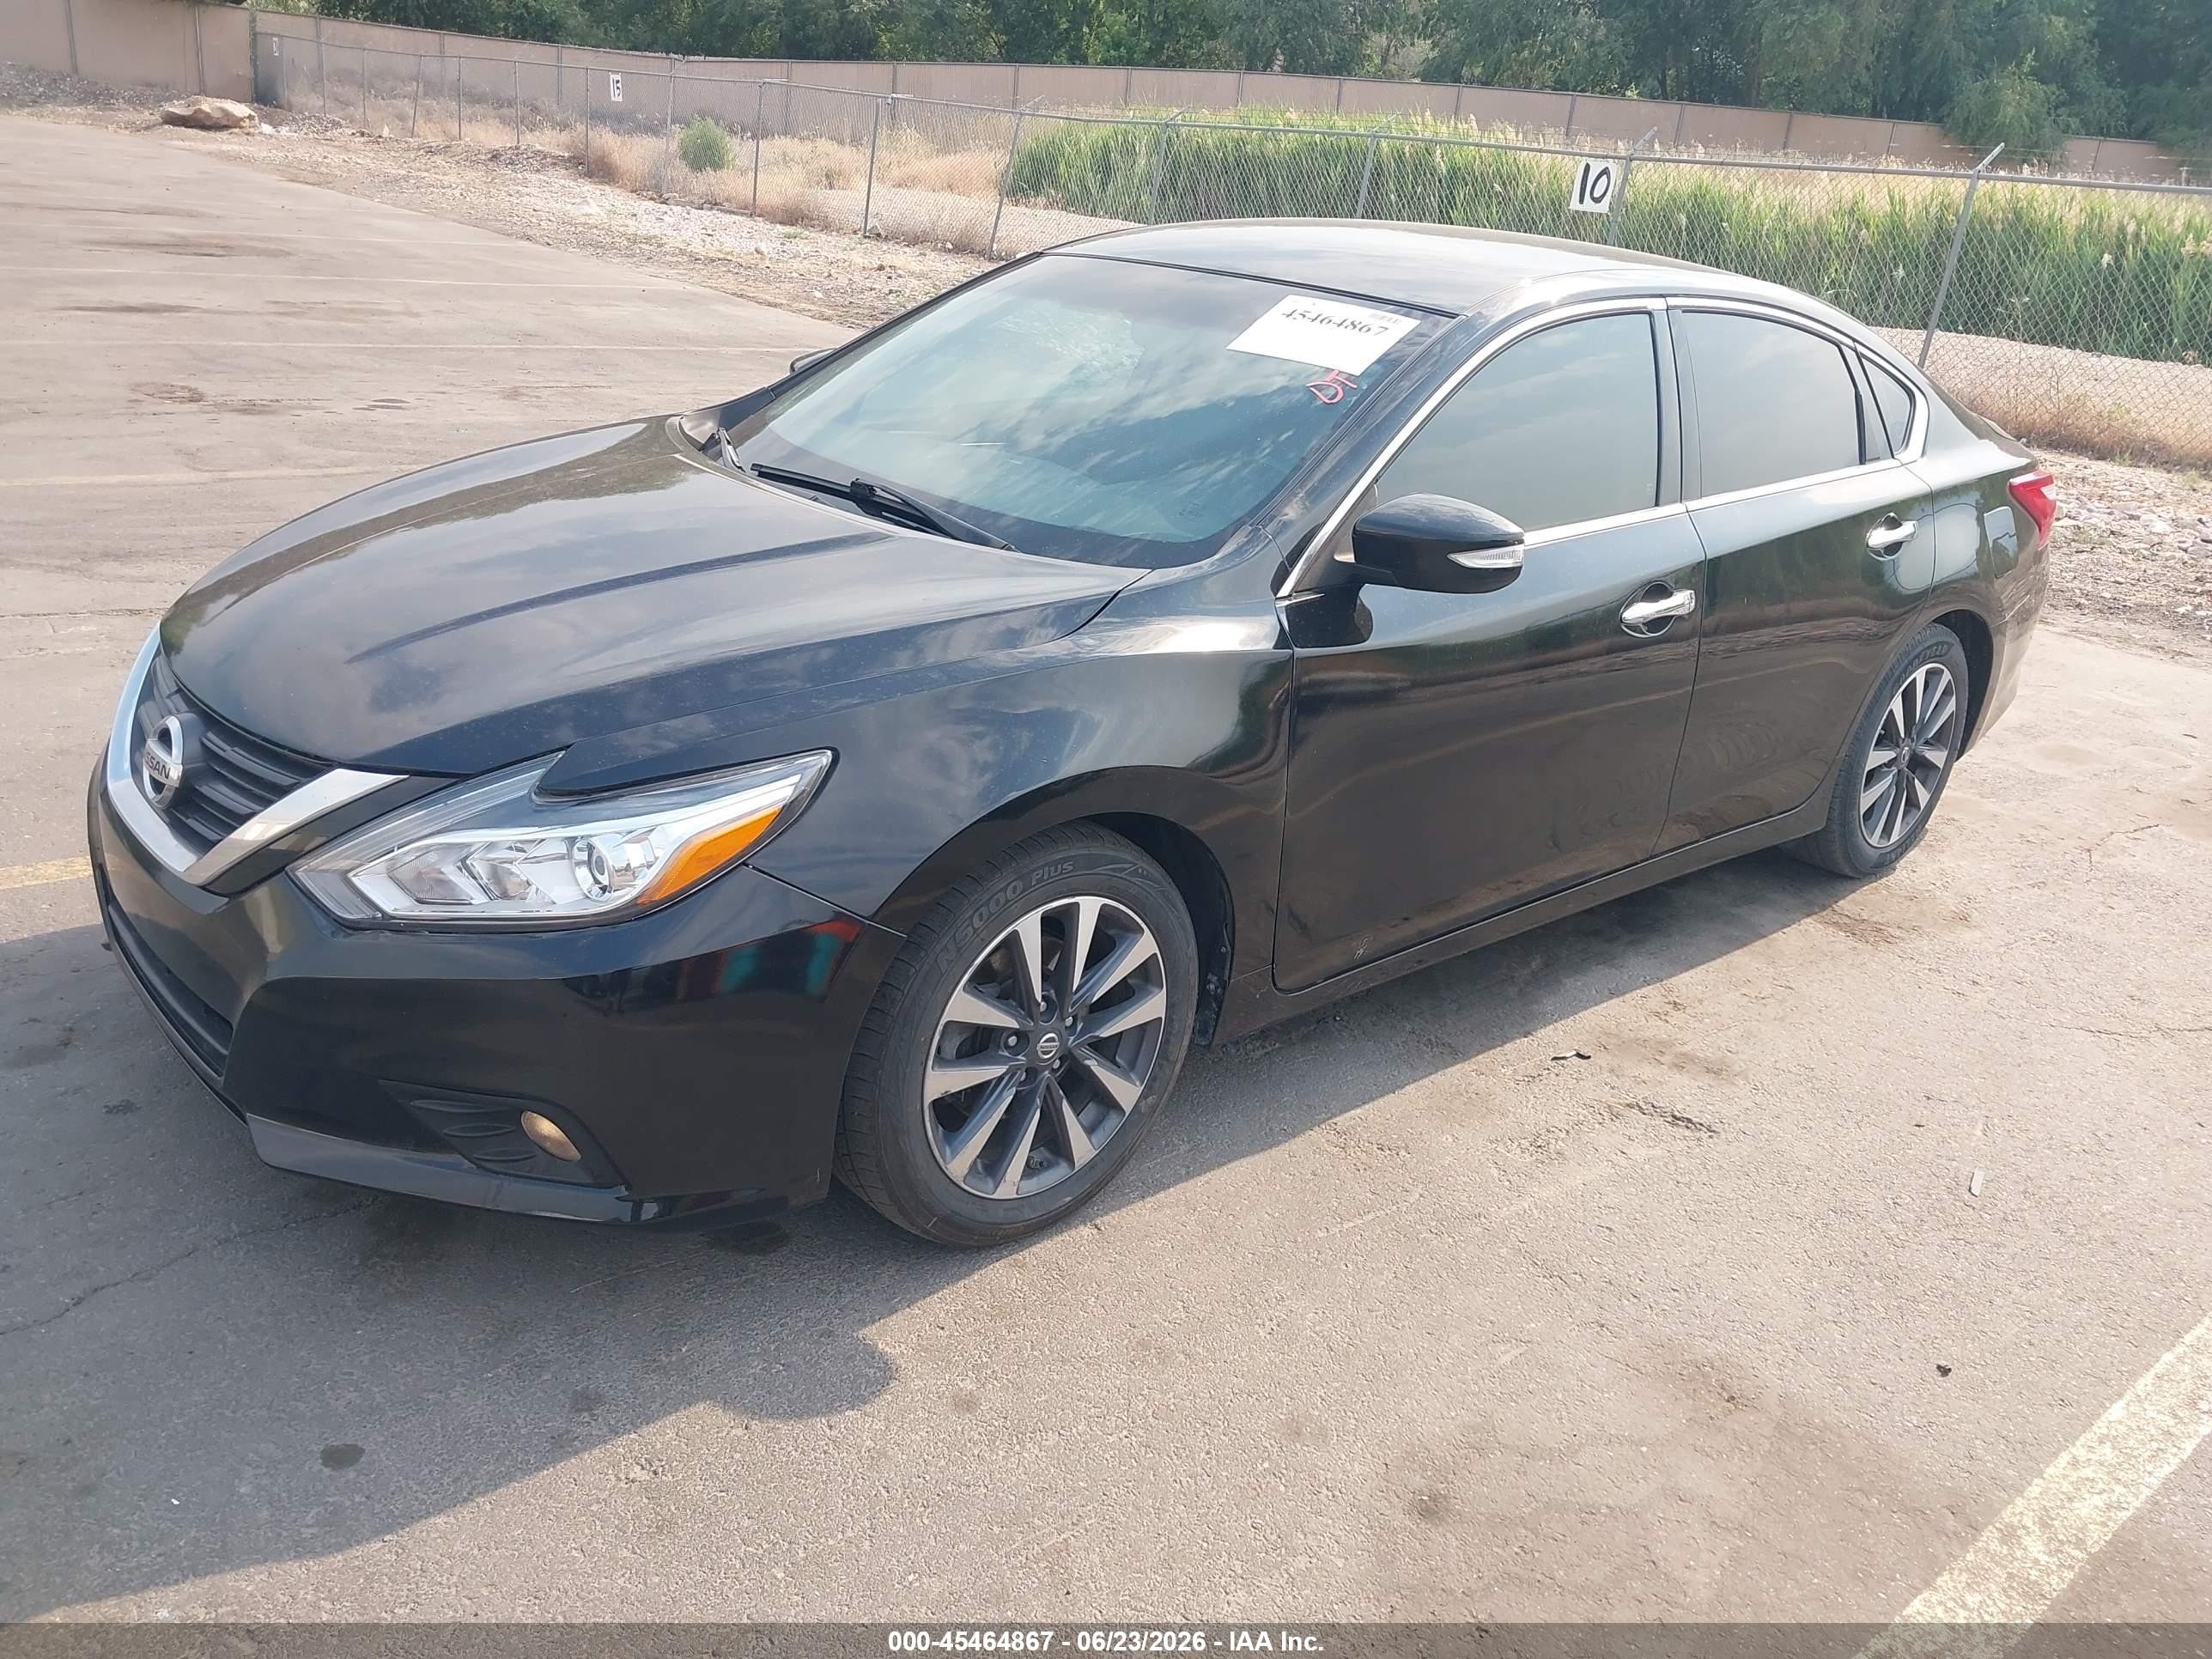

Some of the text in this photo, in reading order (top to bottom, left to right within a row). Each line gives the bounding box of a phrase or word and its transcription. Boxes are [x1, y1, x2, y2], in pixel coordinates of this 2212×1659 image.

[611, 78, 621, 98] 15
[1579, 162, 1611, 204] 10
[1282, 309, 1389, 336] 45464867
[935, 860, 1074, 975] N5000 Plus
